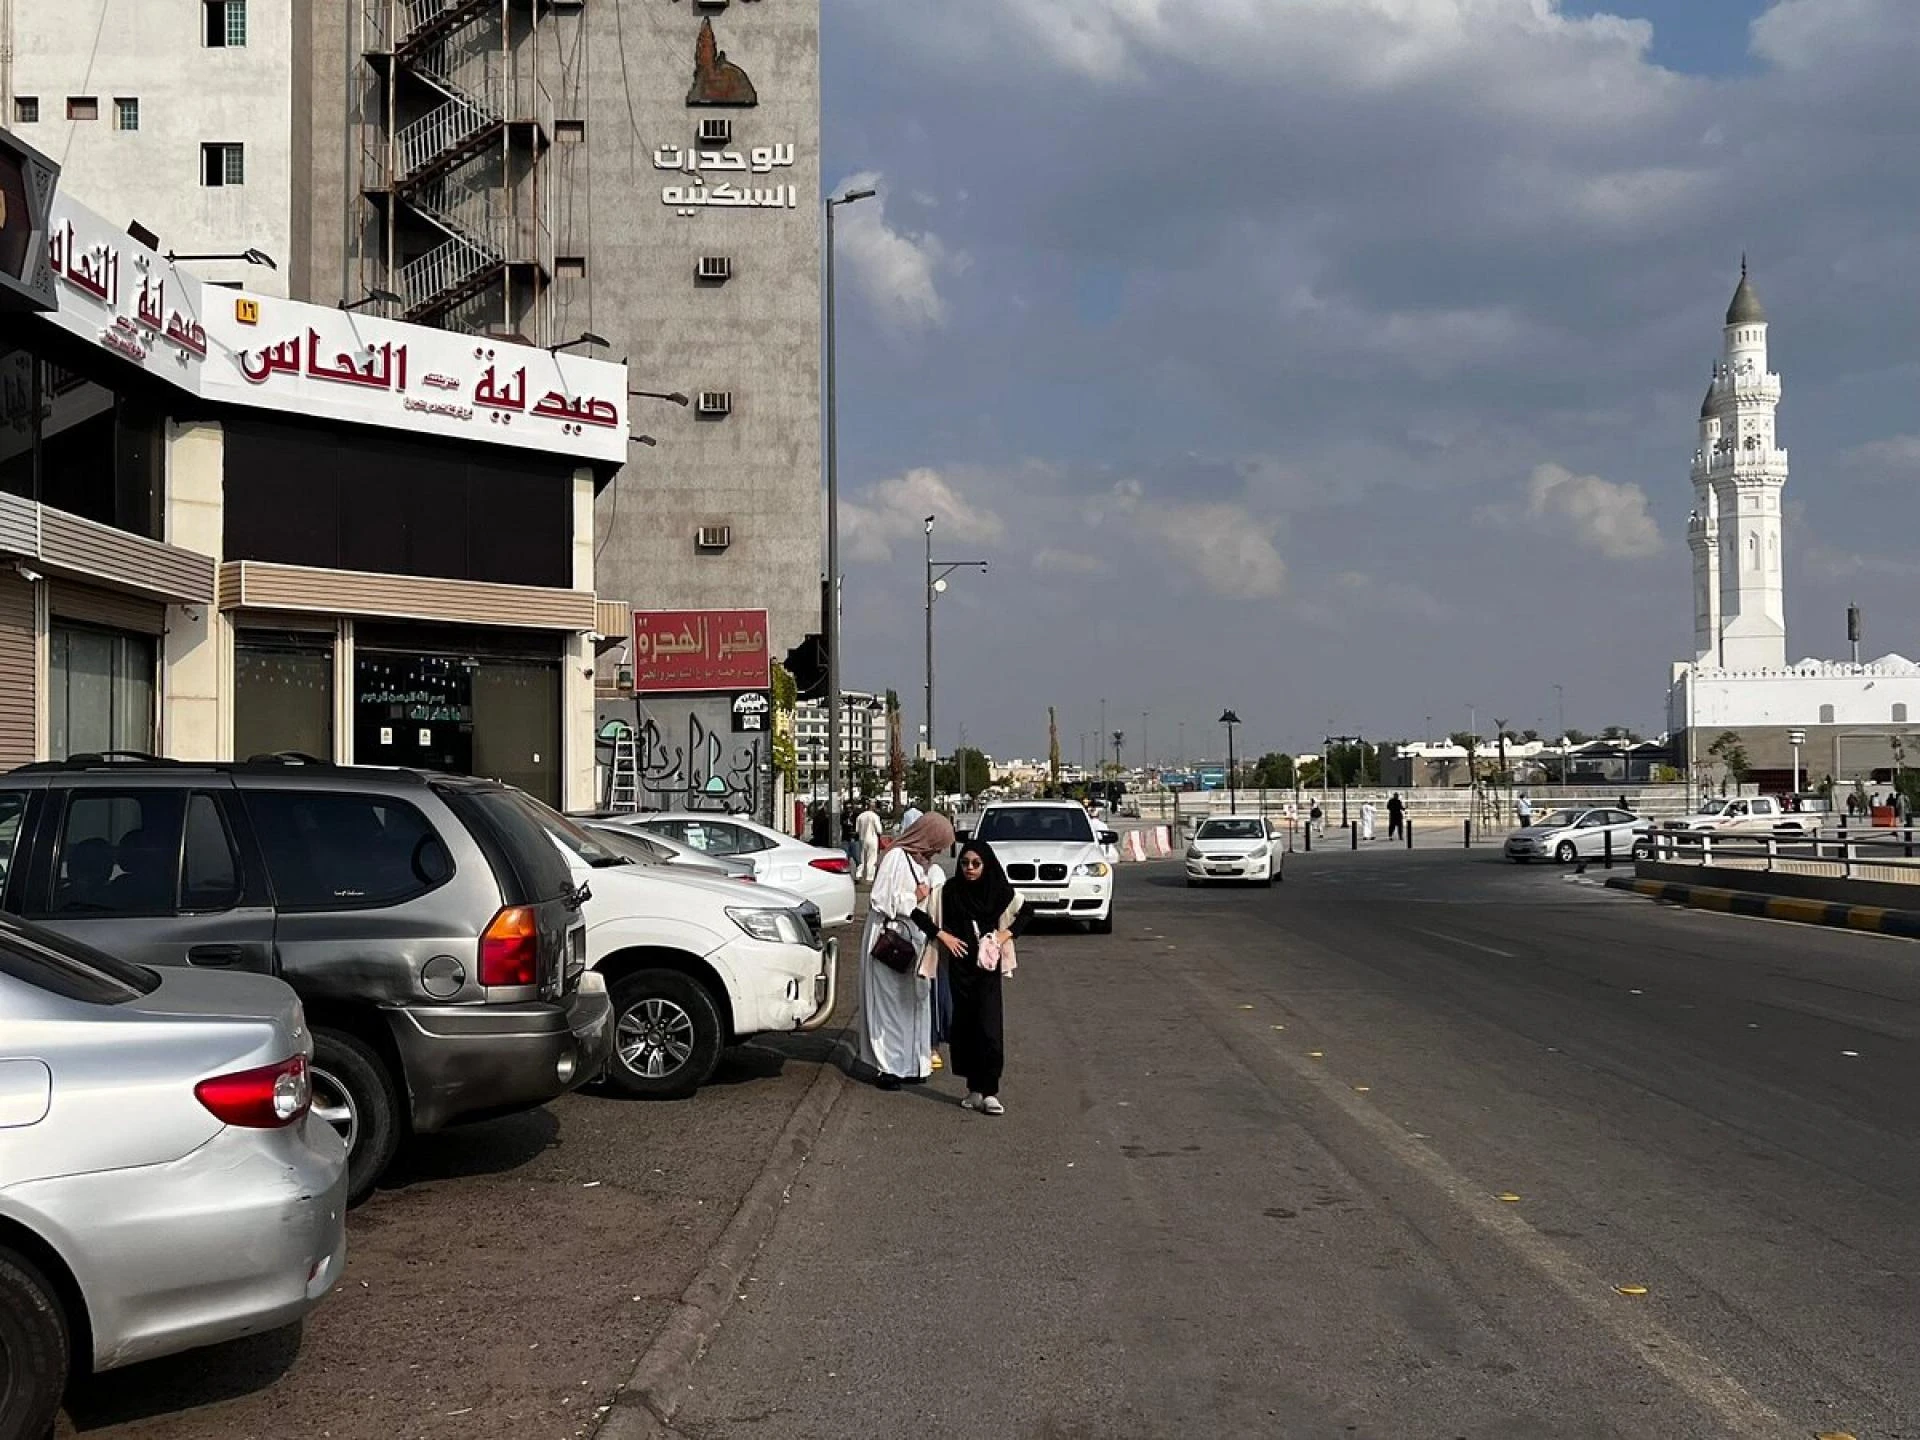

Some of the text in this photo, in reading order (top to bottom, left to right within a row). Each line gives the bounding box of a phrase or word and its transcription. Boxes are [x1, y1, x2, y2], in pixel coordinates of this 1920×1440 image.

[652, 143, 795, 173] للوحدات
[134, 254, 207, 362] صيدلية
[237, 326, 408, 393] النحاس
[473, 346, 619, 436] صيدلية
[638, 615, 763, 664] مخبز الهجرة
